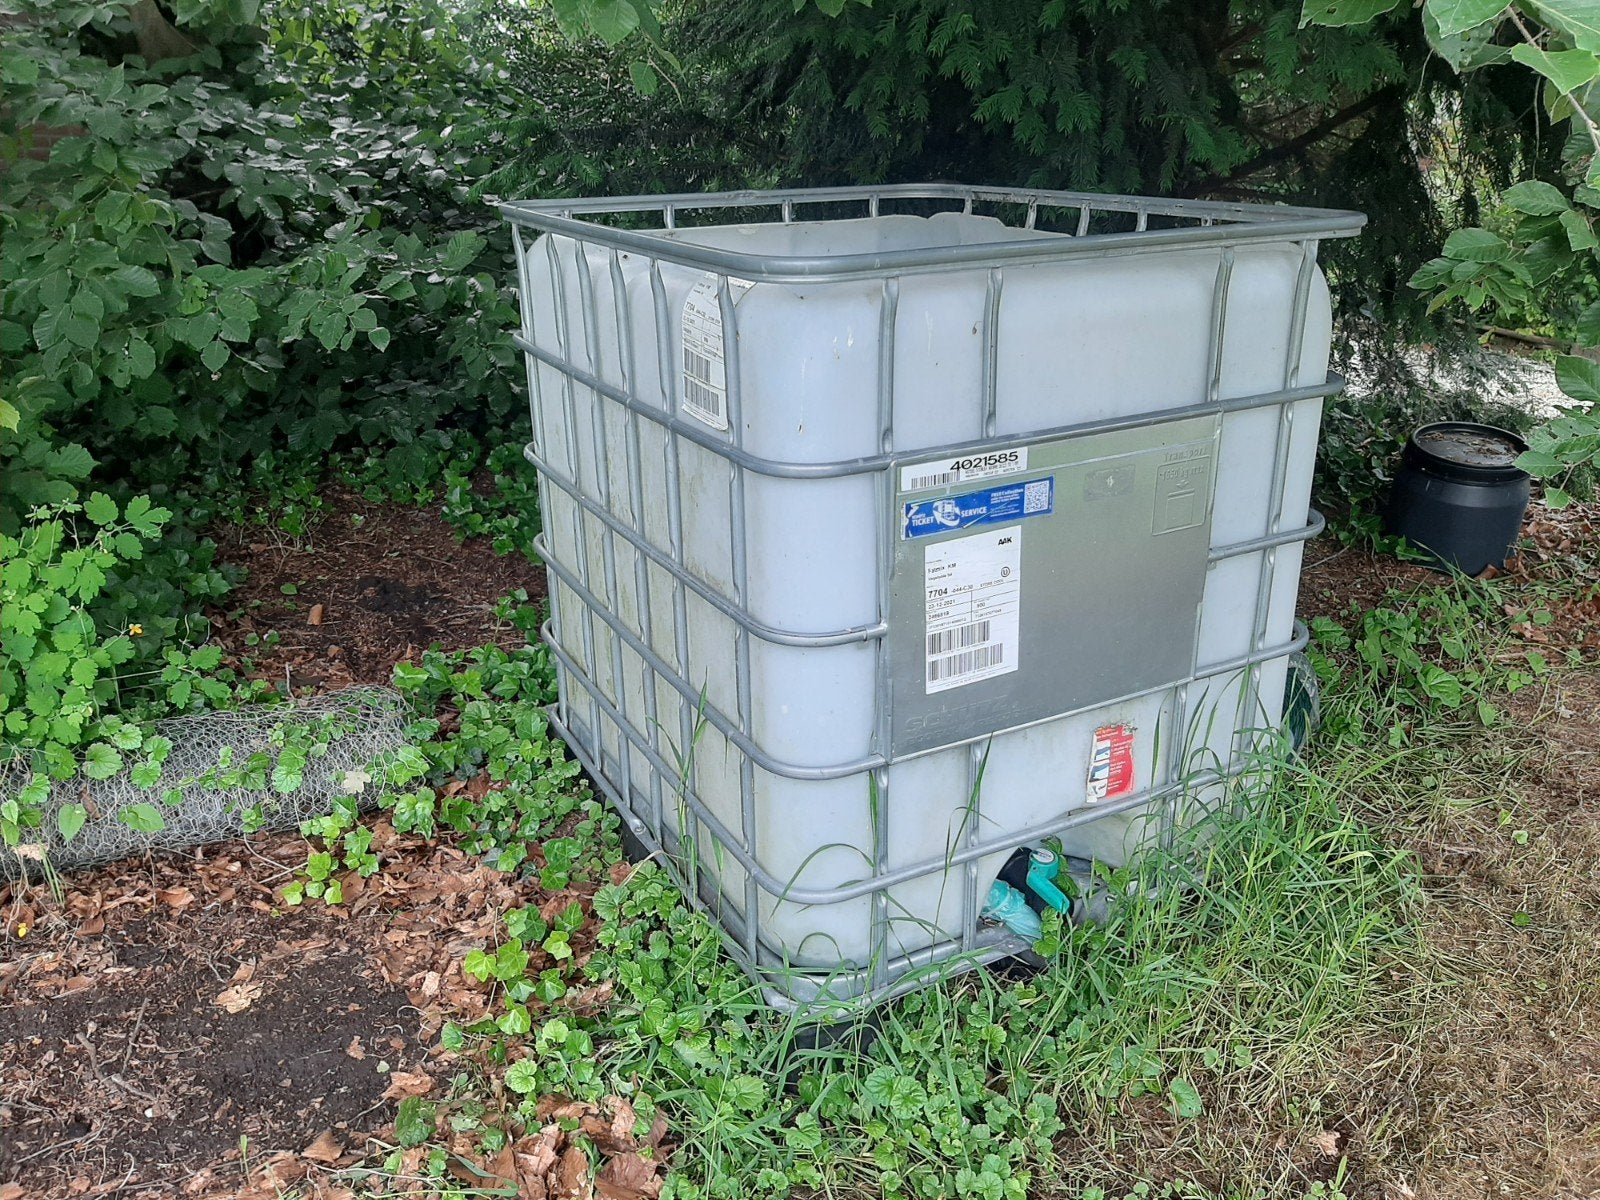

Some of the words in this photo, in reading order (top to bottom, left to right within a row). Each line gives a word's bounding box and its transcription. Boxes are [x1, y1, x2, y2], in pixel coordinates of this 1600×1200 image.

[950, 451, 1018, 471] 4021585
[960, 506, 988, 518] SERVICE
[912, 516, 935, 527] TICKET
[998, 536, 1013, 546] AAK
[928, 587, 948, 599] 7704
